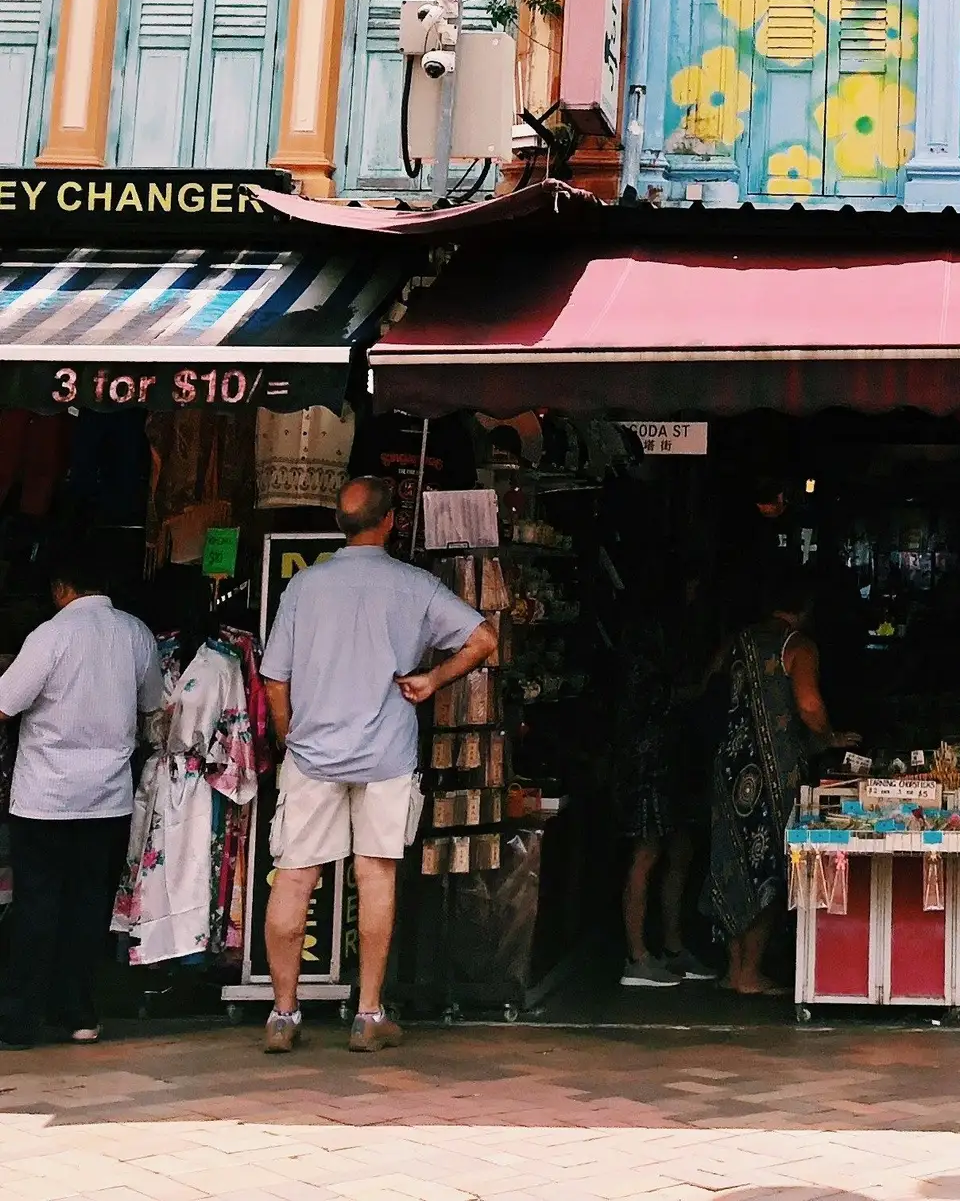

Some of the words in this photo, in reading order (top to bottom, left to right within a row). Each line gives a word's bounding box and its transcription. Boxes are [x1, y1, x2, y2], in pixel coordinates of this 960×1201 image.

[57, 181, 264, 213] CHANGER
[52, 367, 78, 403] 3
[93, 369, 157, 403] for
[672, 424, 691, 438] ST
